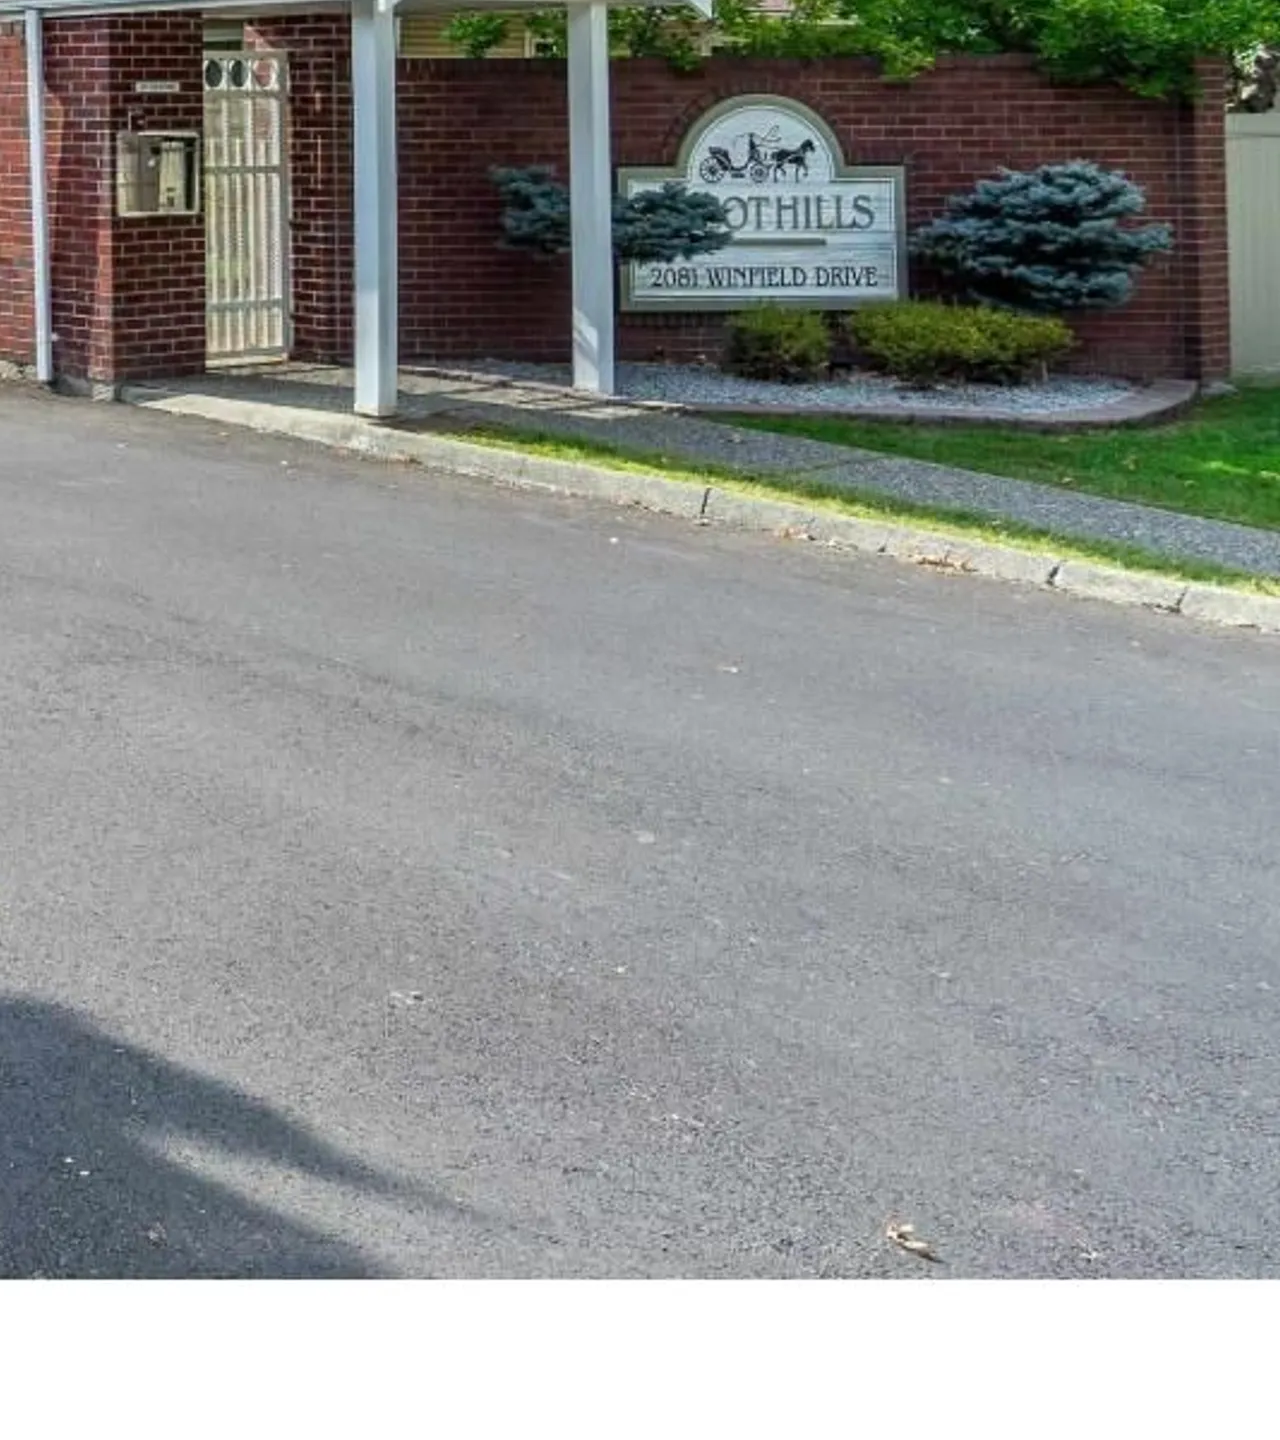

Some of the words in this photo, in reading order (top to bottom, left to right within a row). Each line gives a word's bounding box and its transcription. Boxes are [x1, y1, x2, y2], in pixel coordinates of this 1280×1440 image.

[649, 266, 699, 288] 2081
[706, 266, 807, 288] WINFIELD
[814, 266, 878, 288] DRIVE
